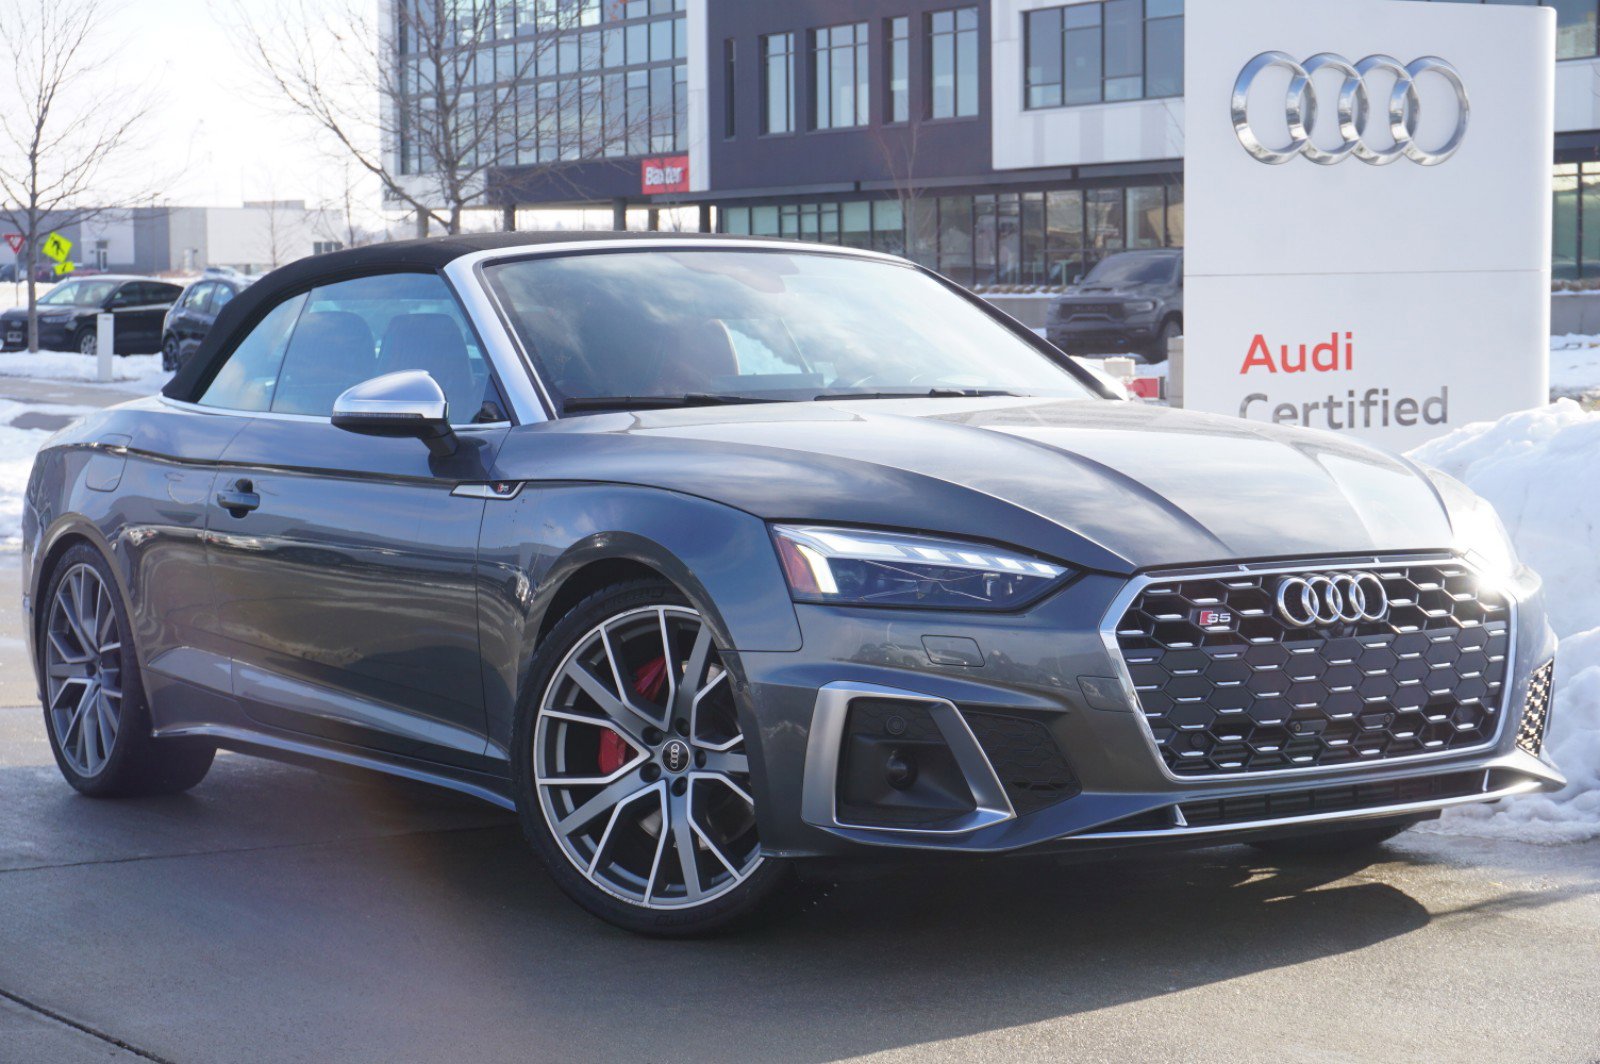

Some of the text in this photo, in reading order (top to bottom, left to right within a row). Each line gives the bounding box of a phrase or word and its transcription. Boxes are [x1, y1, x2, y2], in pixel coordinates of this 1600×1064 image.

[1240, 332, 1353, 374] Audi
[1239, 386, 1448, 430] Certified
[1207, 613, 1231, 623] S5
